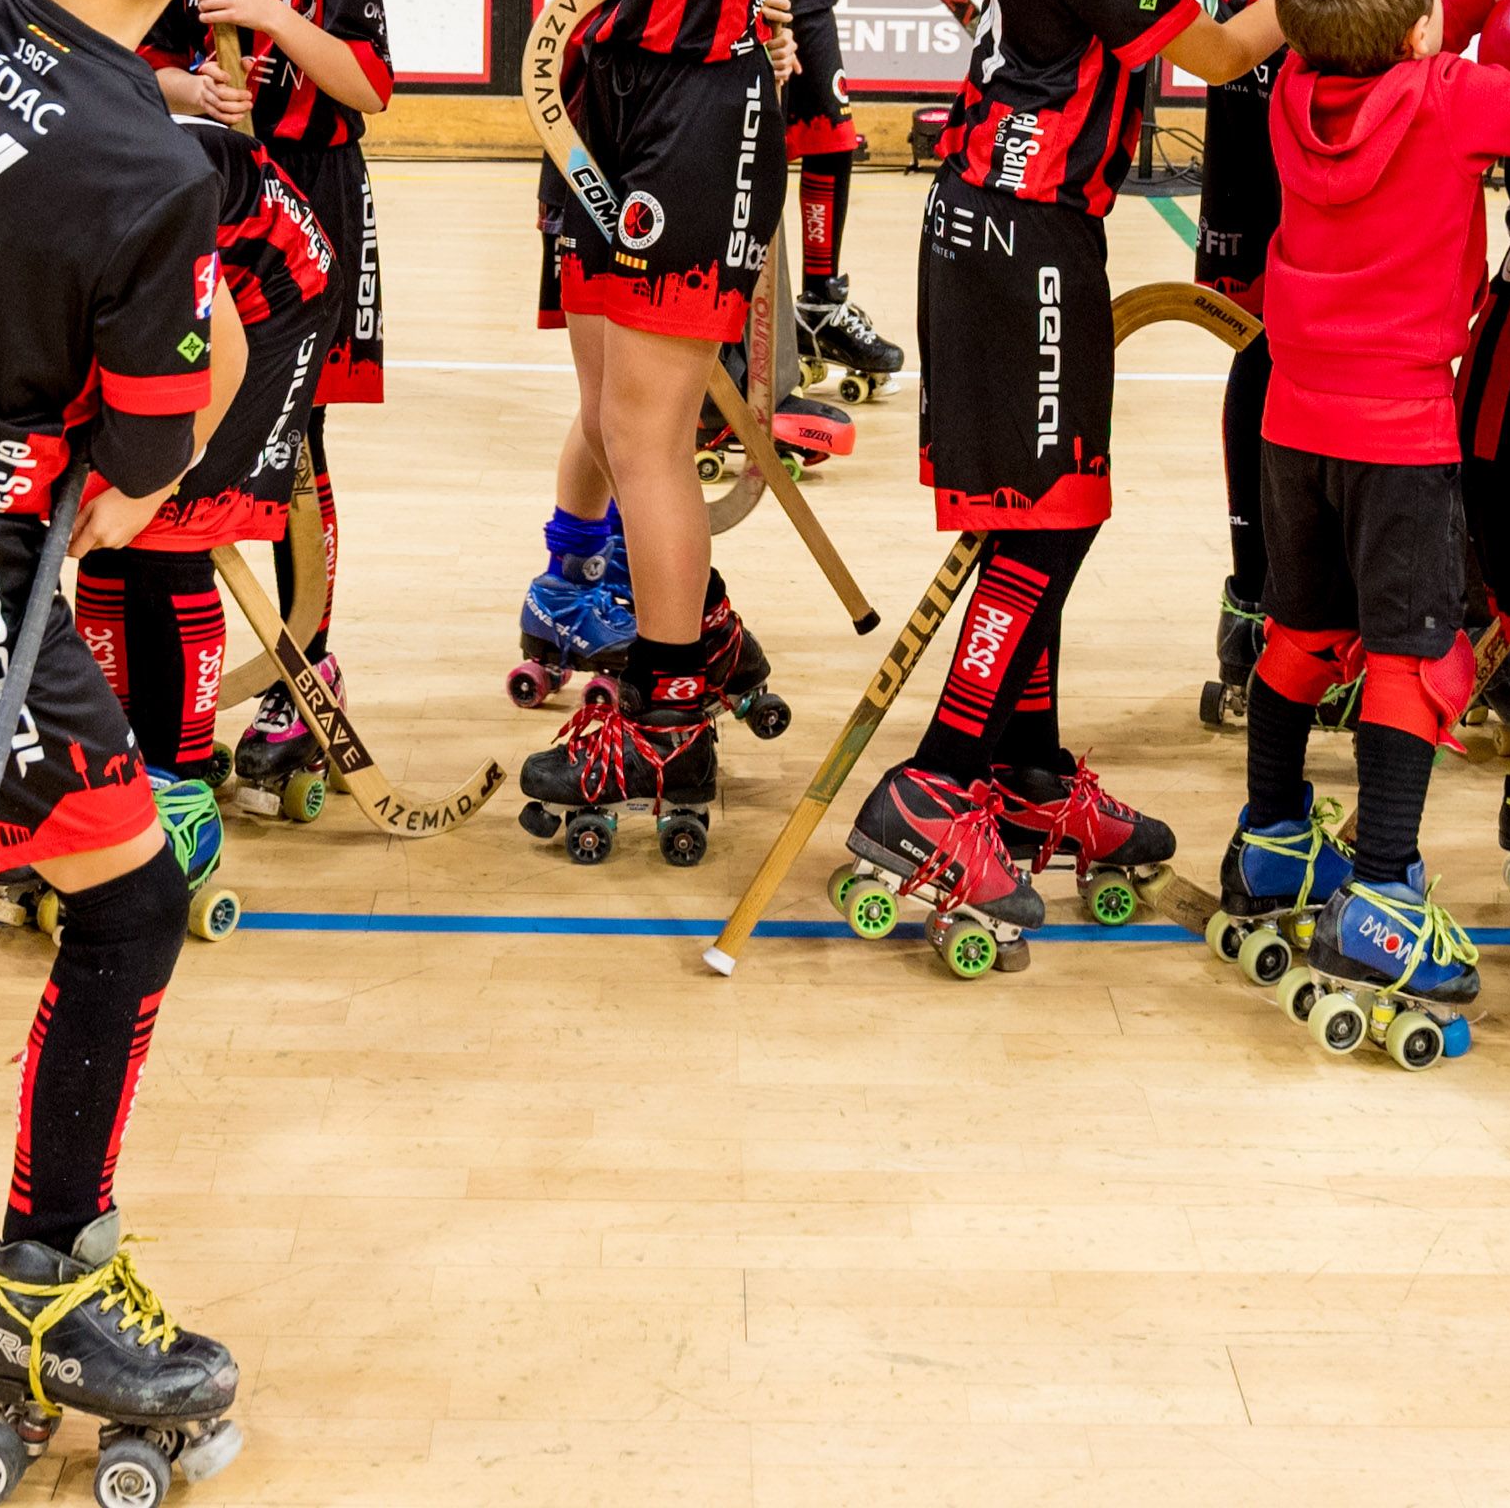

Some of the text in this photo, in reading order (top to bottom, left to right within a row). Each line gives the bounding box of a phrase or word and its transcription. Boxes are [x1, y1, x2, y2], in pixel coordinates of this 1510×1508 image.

[14, 38, 60, 75] 1967
[1001, 132, 1039, 192] Sant
[807, 203, 825, 243] PHCSC
[961, 601, 1013, 679] PHCSC
[194, 644, 224, 714] PHCSC
[293, 670, 361, 769] BRAVE
[373, 793, 479, 834] AZEMAD.
